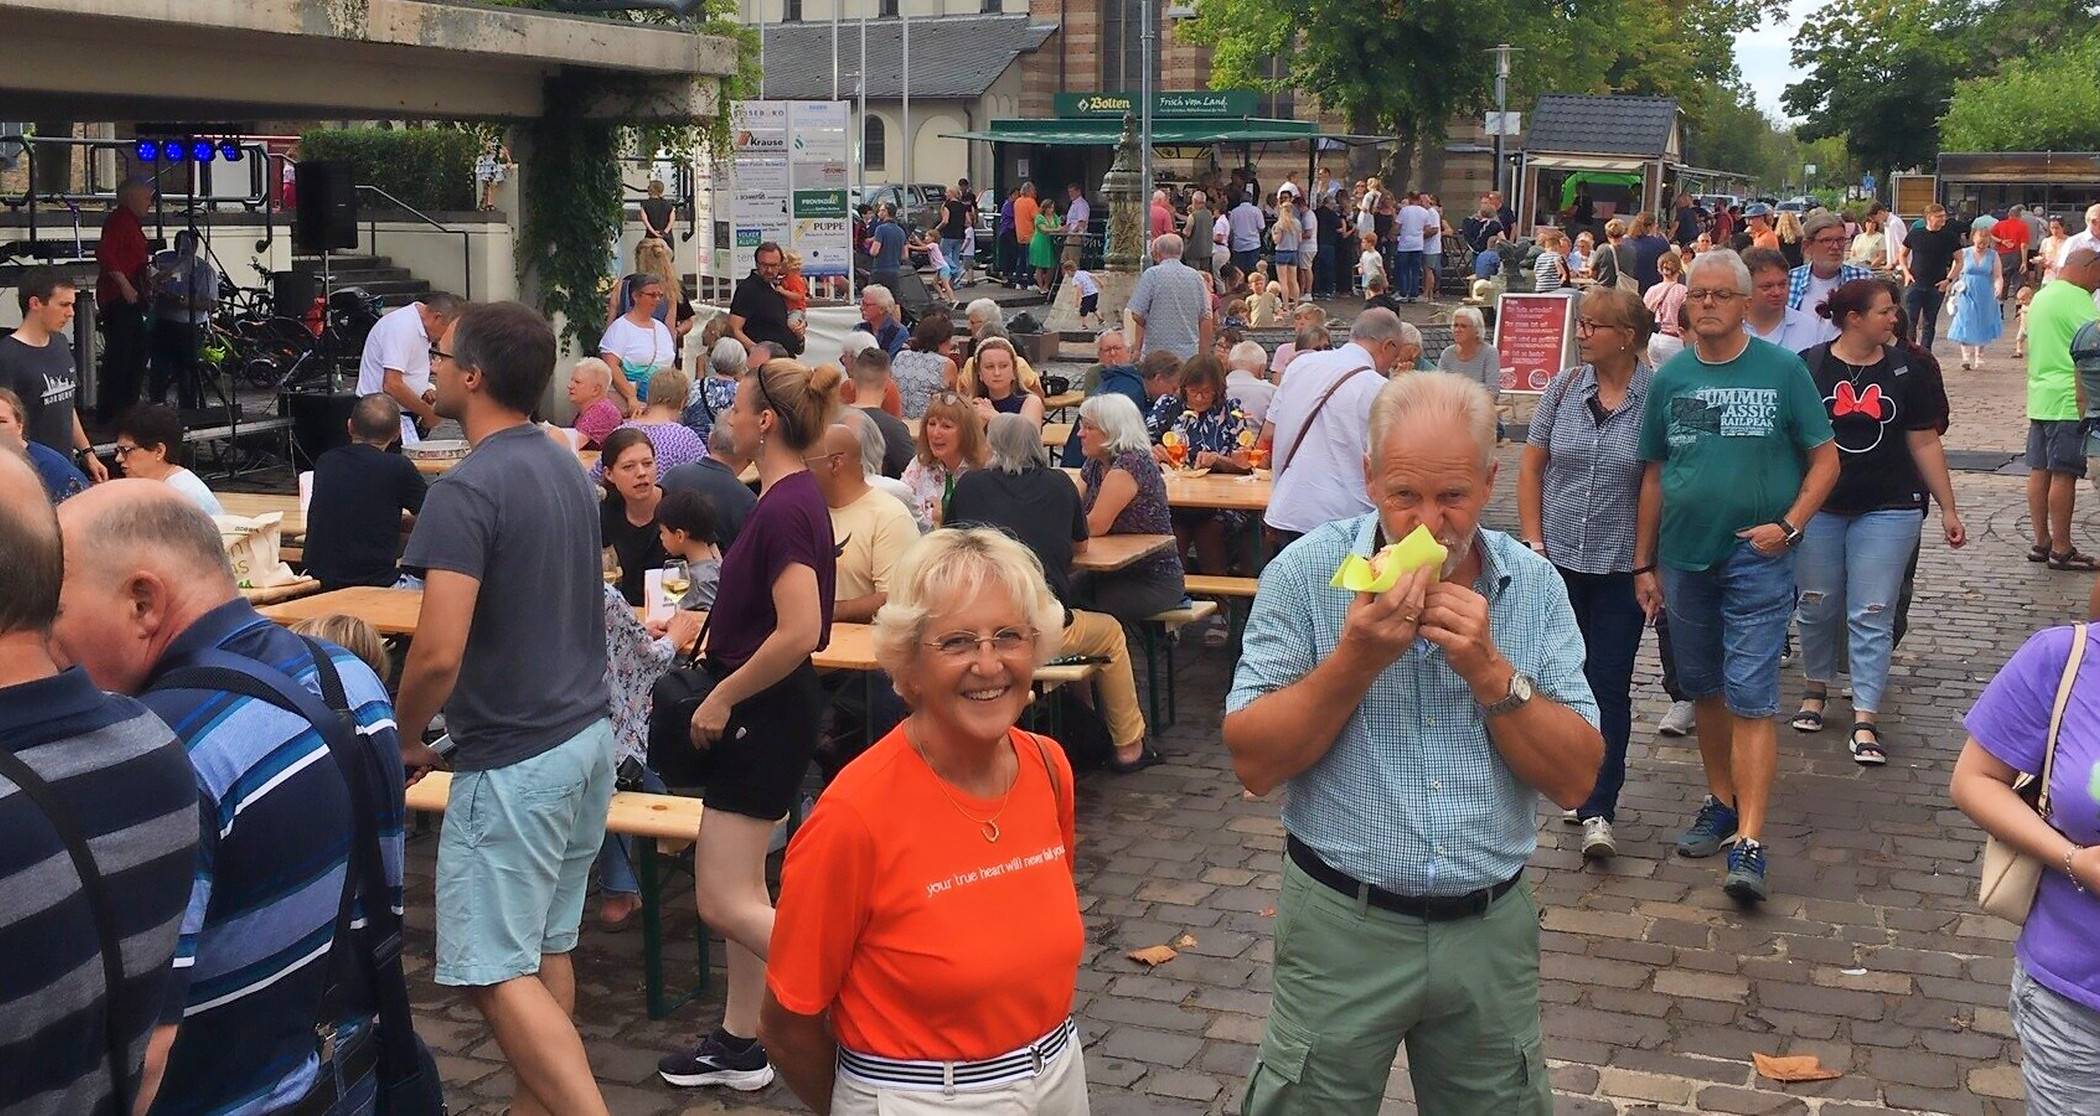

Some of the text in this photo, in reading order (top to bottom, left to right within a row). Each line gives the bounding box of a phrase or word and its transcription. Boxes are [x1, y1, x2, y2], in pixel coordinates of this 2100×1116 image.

[1090, 97, 1131, 109] Bolten
[1160, 97, 1183, 106] Frisch
[1185, 98, 1202, 106] vom
[750, 138, 783, 146] Krause
[813, 222, 845, 231] PUPPE
[1695, 389, 1778, 406] SUMMIT
[927, 880, 952, 898] your
[955, 872, 978, 886] true
[979, 865, 1005, 879] heart
[1006, 857, 1023, 871] will
[1024, 854, 1043, 867] never
